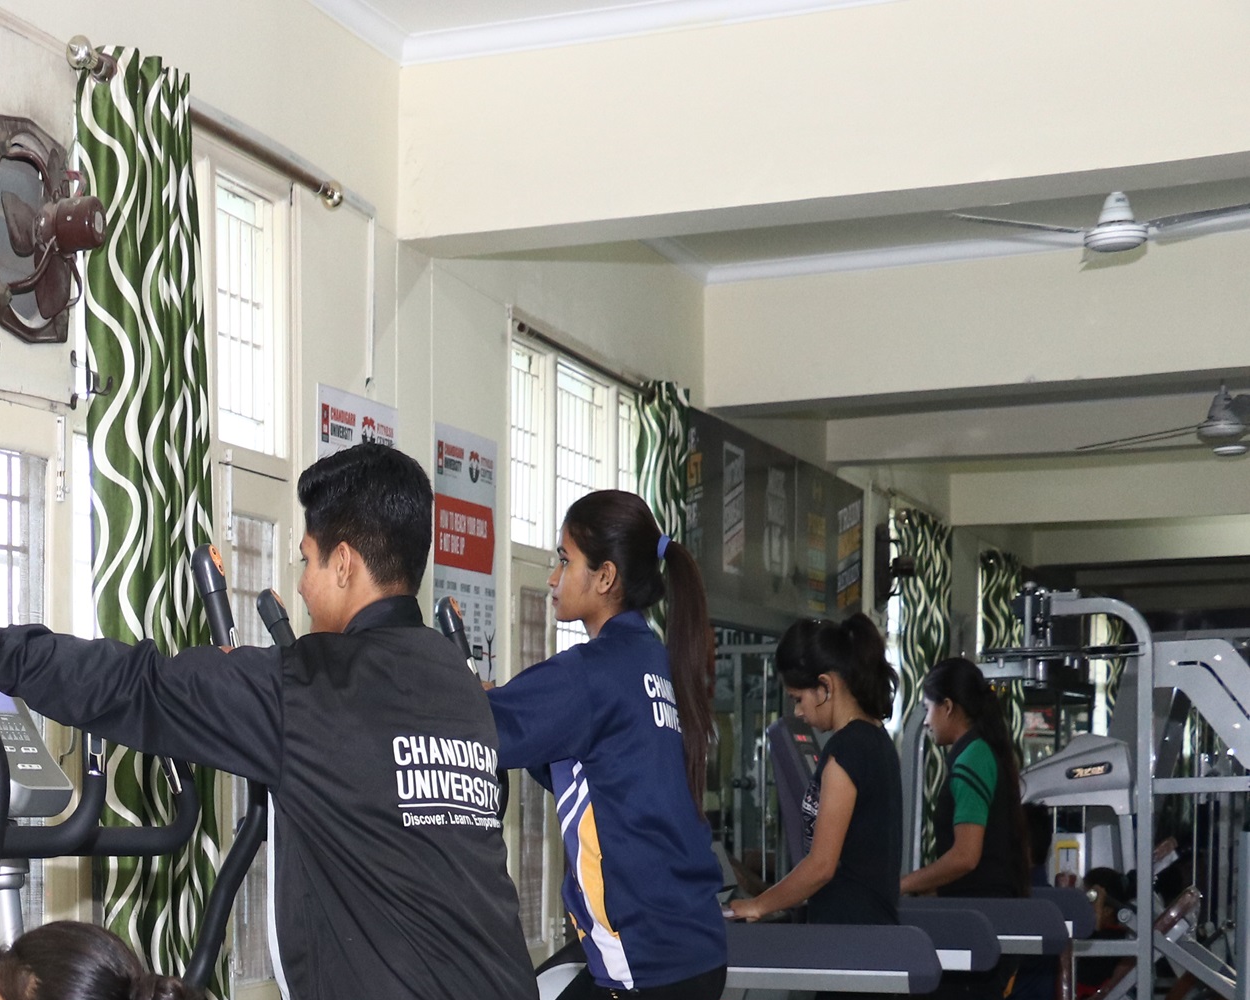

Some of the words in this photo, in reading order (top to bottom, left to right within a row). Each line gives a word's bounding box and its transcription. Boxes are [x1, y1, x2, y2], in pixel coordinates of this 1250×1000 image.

[392, 736, 498, 780] CHANDIGAR
[396, 769, 500, 812] UNIVERSITY
[402, 812, 448, 827] Discover.
[447, 811, 474, 826] Learn.
